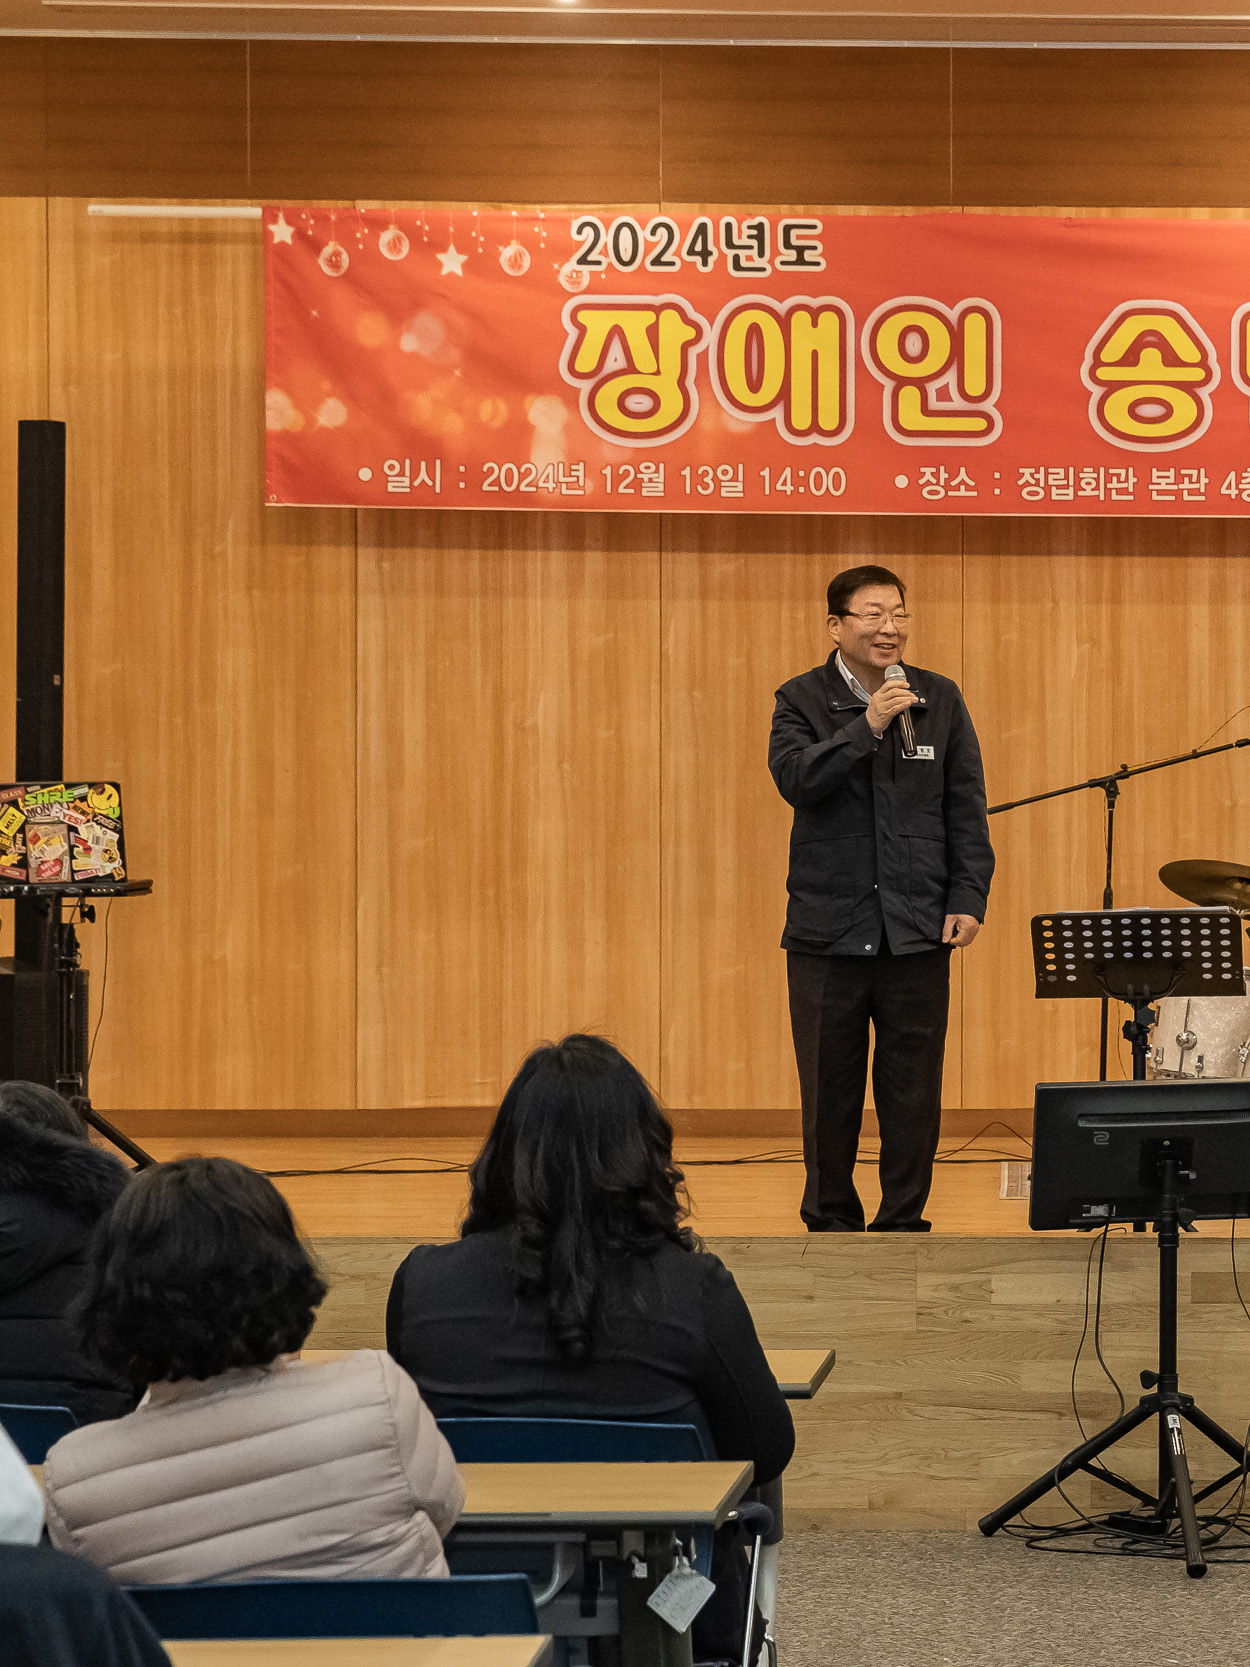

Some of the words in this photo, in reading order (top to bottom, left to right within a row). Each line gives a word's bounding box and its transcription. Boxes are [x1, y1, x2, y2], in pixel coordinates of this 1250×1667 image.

[573, 219, 823, 274] 2024년도
[561, 296, 1000, 447] 장애인
[384, 459, 441, 493] 일시
[482, 460, 586, 495] 2024년
[602, 462, 665, 497] 12월
[681, 464, 744, 498] 13일
[760, 467, 846, 496] 14:00
[918, 466, 978, 500] 장소
[1017, 467, 1138, 501] 정립회관
[1148, 468, 1210, 501] 본관
